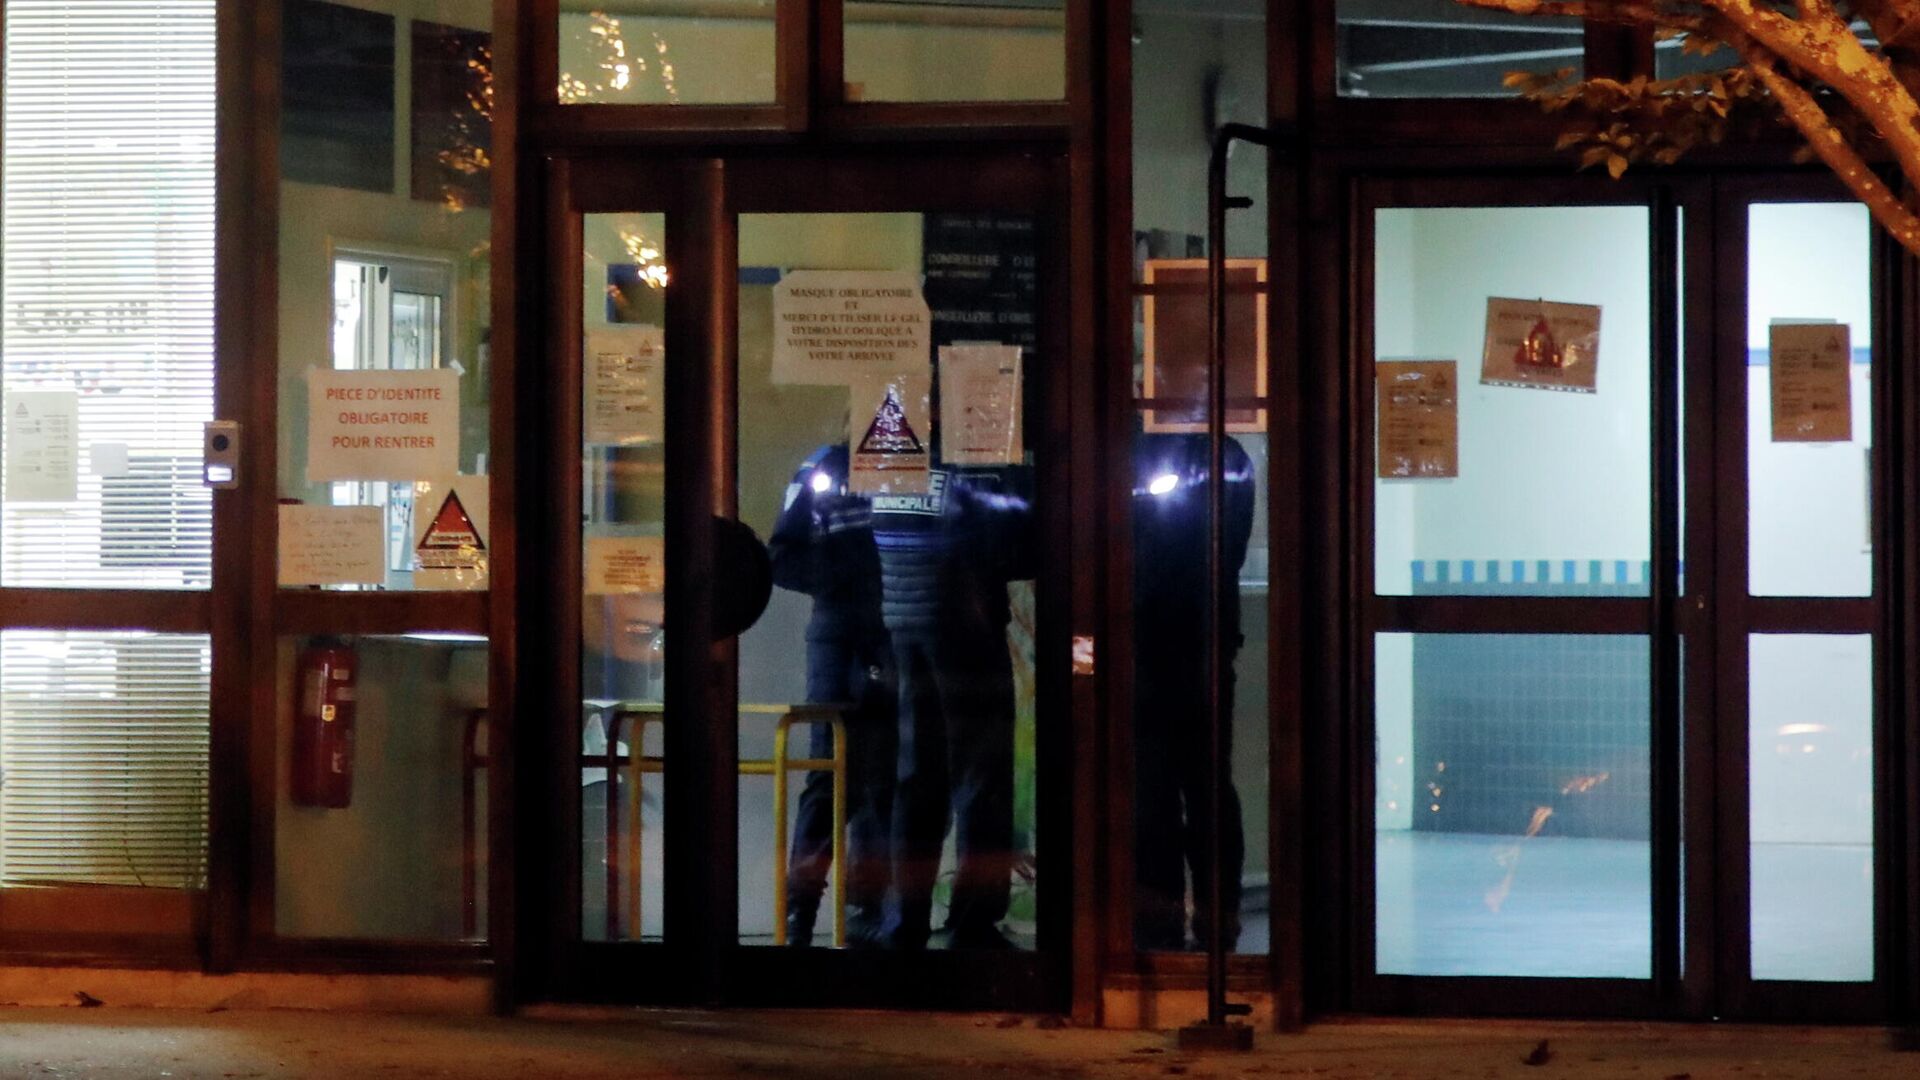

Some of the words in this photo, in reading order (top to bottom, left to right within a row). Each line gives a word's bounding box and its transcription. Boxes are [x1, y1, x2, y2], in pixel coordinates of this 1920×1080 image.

[790, 288, 835, 298] MASQUE
[838, 288, 913, 298] OBLIGATOIRE
[844, 301, 859, 310] ET
[782, 313, 817, 322] MERCI
[884, 314, 898, 323] LE
[901, 314, 922, 323] GEL
[787, 339, 824, 348] VOTRE
[826, 339, 894, 348] DISPOSITION
[808, 352, 843, 361] VOTRE
[326, 388, 363, 400] PIECE
[367, 388, 441, 400] D'IDENTITE
[338, 412, 428, 424] OBLIGATOIRE
[332, 436, 370, 448] POUR
[375, 436, 434, 448] RENTRER
